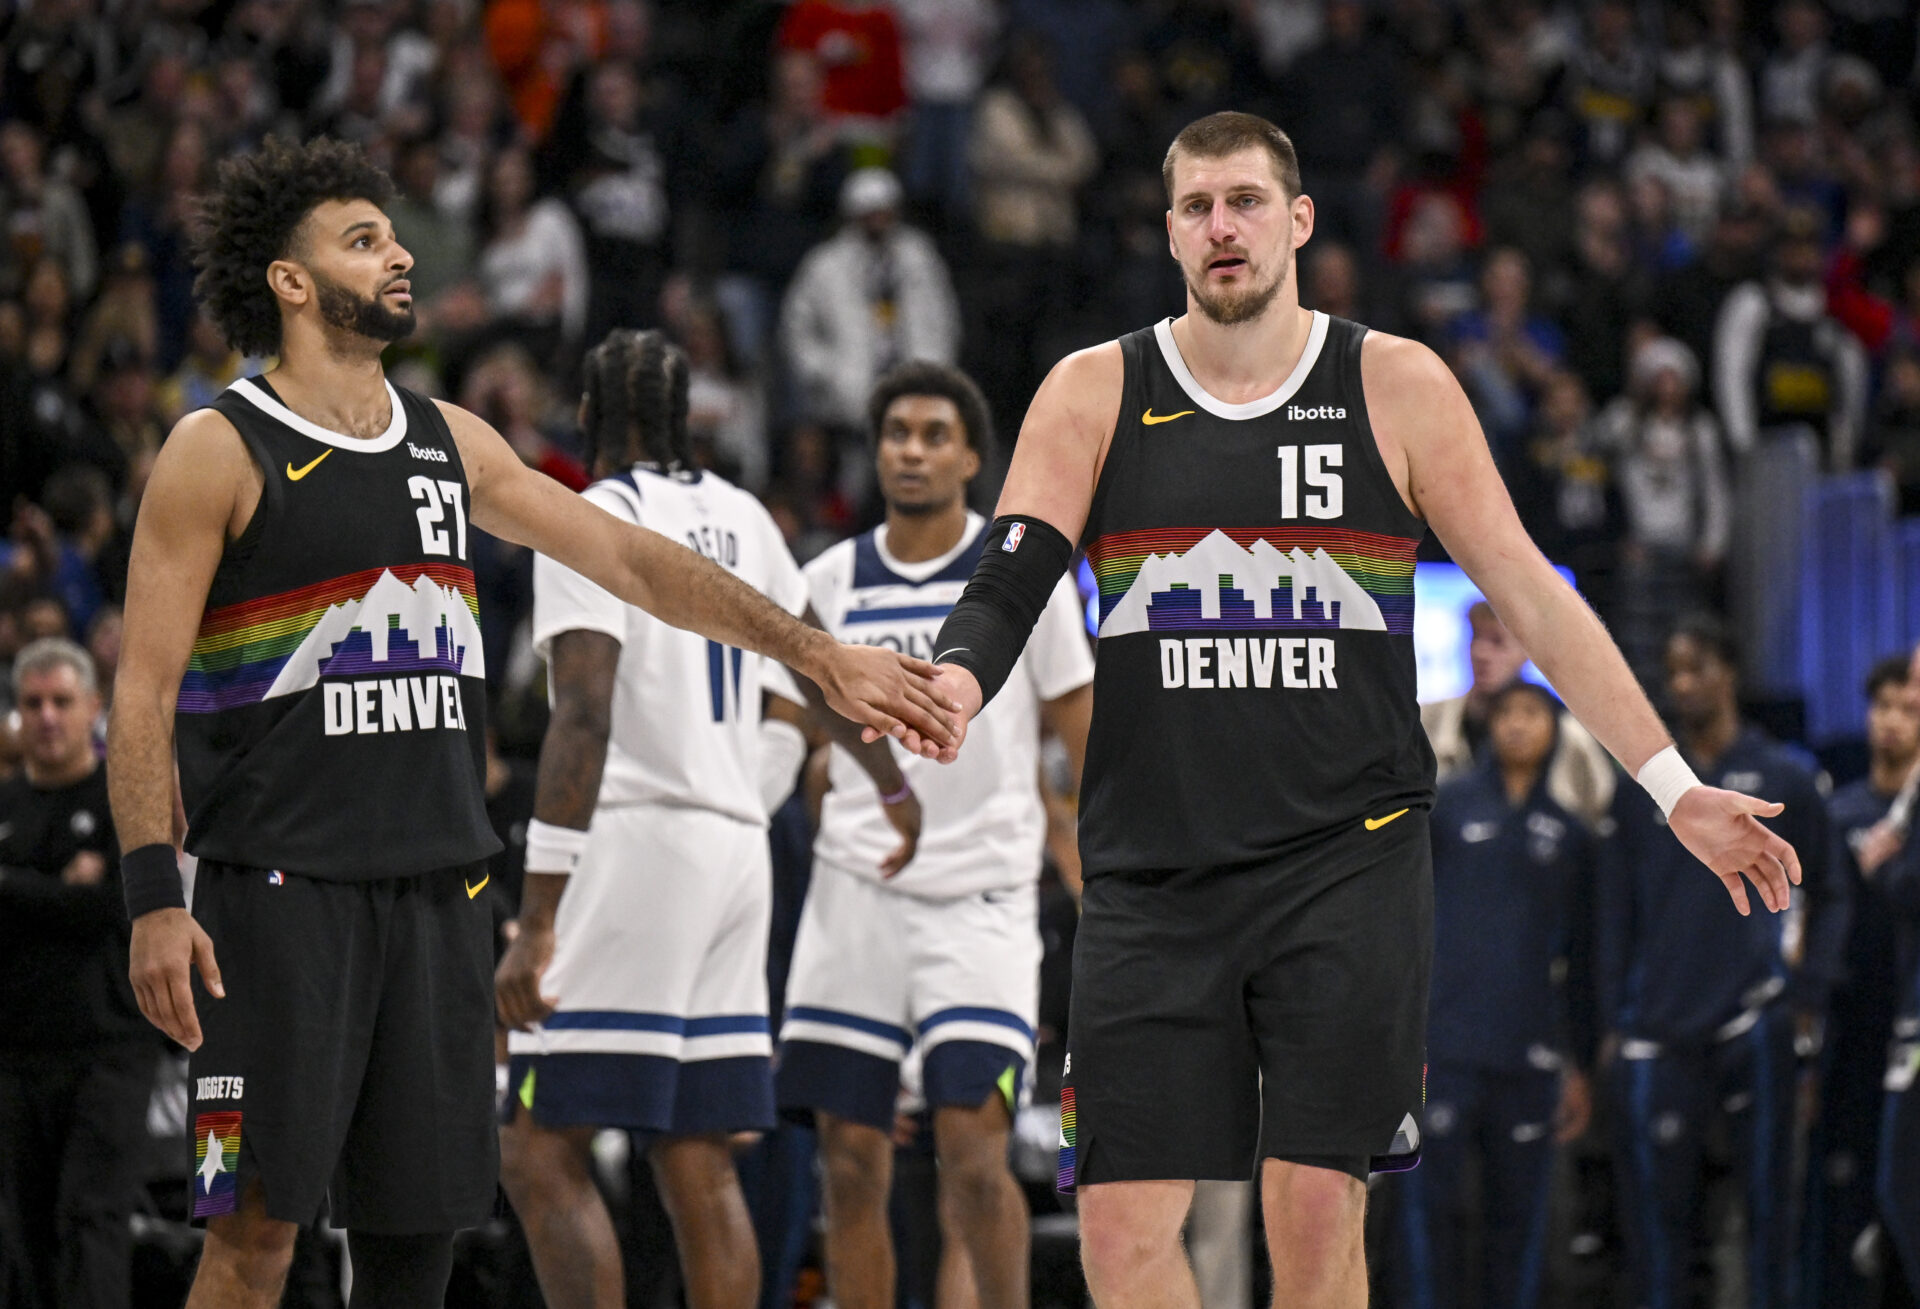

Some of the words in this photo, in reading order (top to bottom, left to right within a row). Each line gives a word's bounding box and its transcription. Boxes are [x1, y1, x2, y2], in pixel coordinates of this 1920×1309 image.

[1287, 405, 1347, 421] ibotta
[407, 442, 449, 463] ibotta
[1277, 443, 1343, 519] 15
[407, 475, 467, 561] 27
[1159, 637, 1338, 689] DENVER
